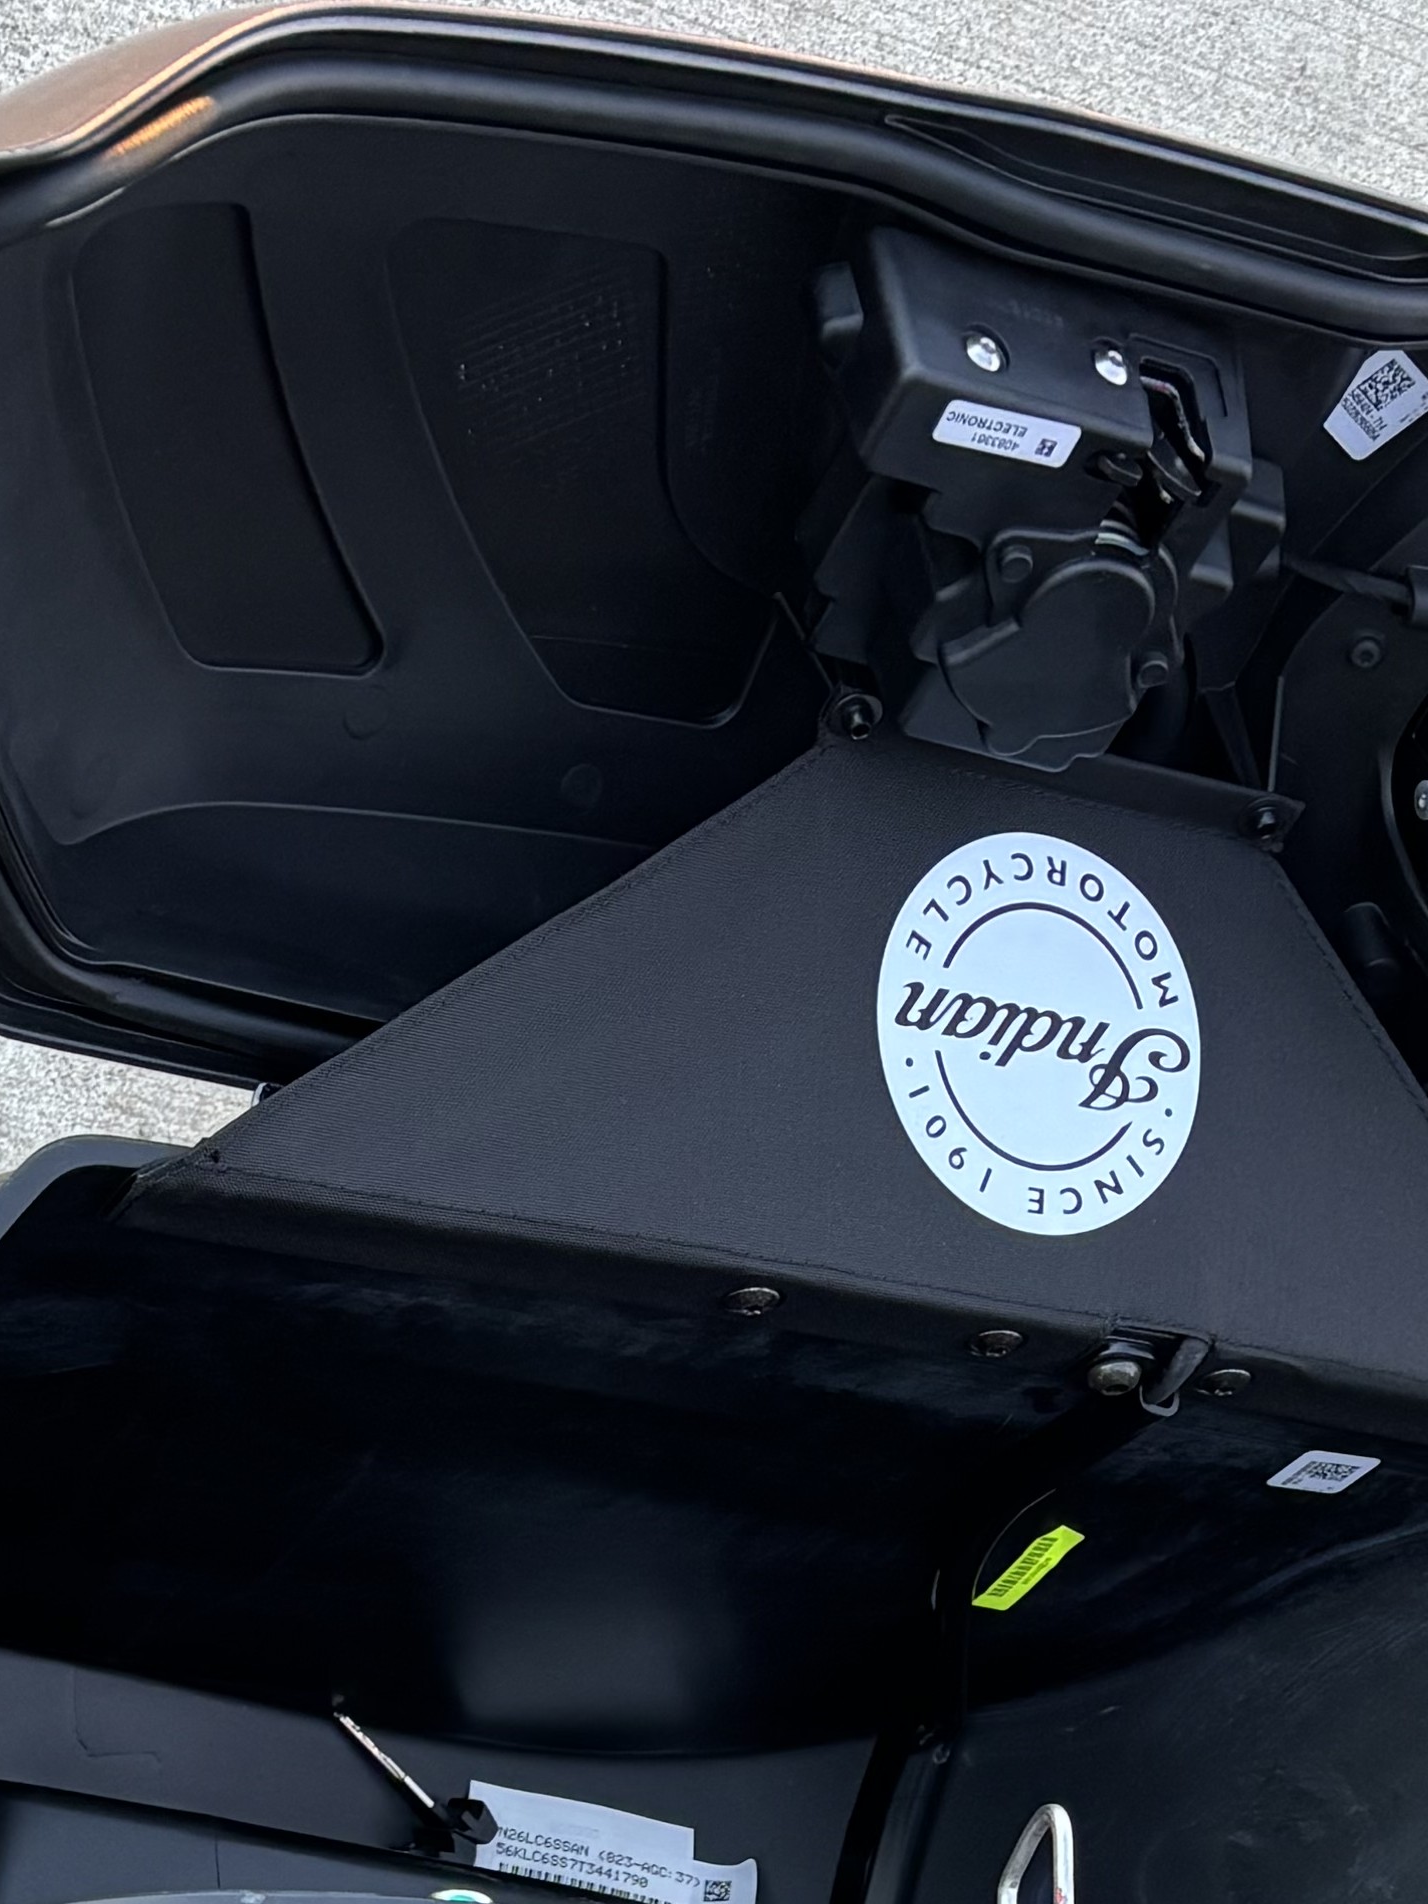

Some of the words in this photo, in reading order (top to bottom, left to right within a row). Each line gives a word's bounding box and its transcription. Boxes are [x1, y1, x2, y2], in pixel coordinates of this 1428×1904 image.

[946, 411, 1028, 438] ELECTRONIC
[903, 850, 1181, 1010] MOTORCYCLE
[896, 979, 1191, 1112] Indian
[908, 1084, 993, 1193] 1901
[1026, 1129, 1168, 1217] SINCE
